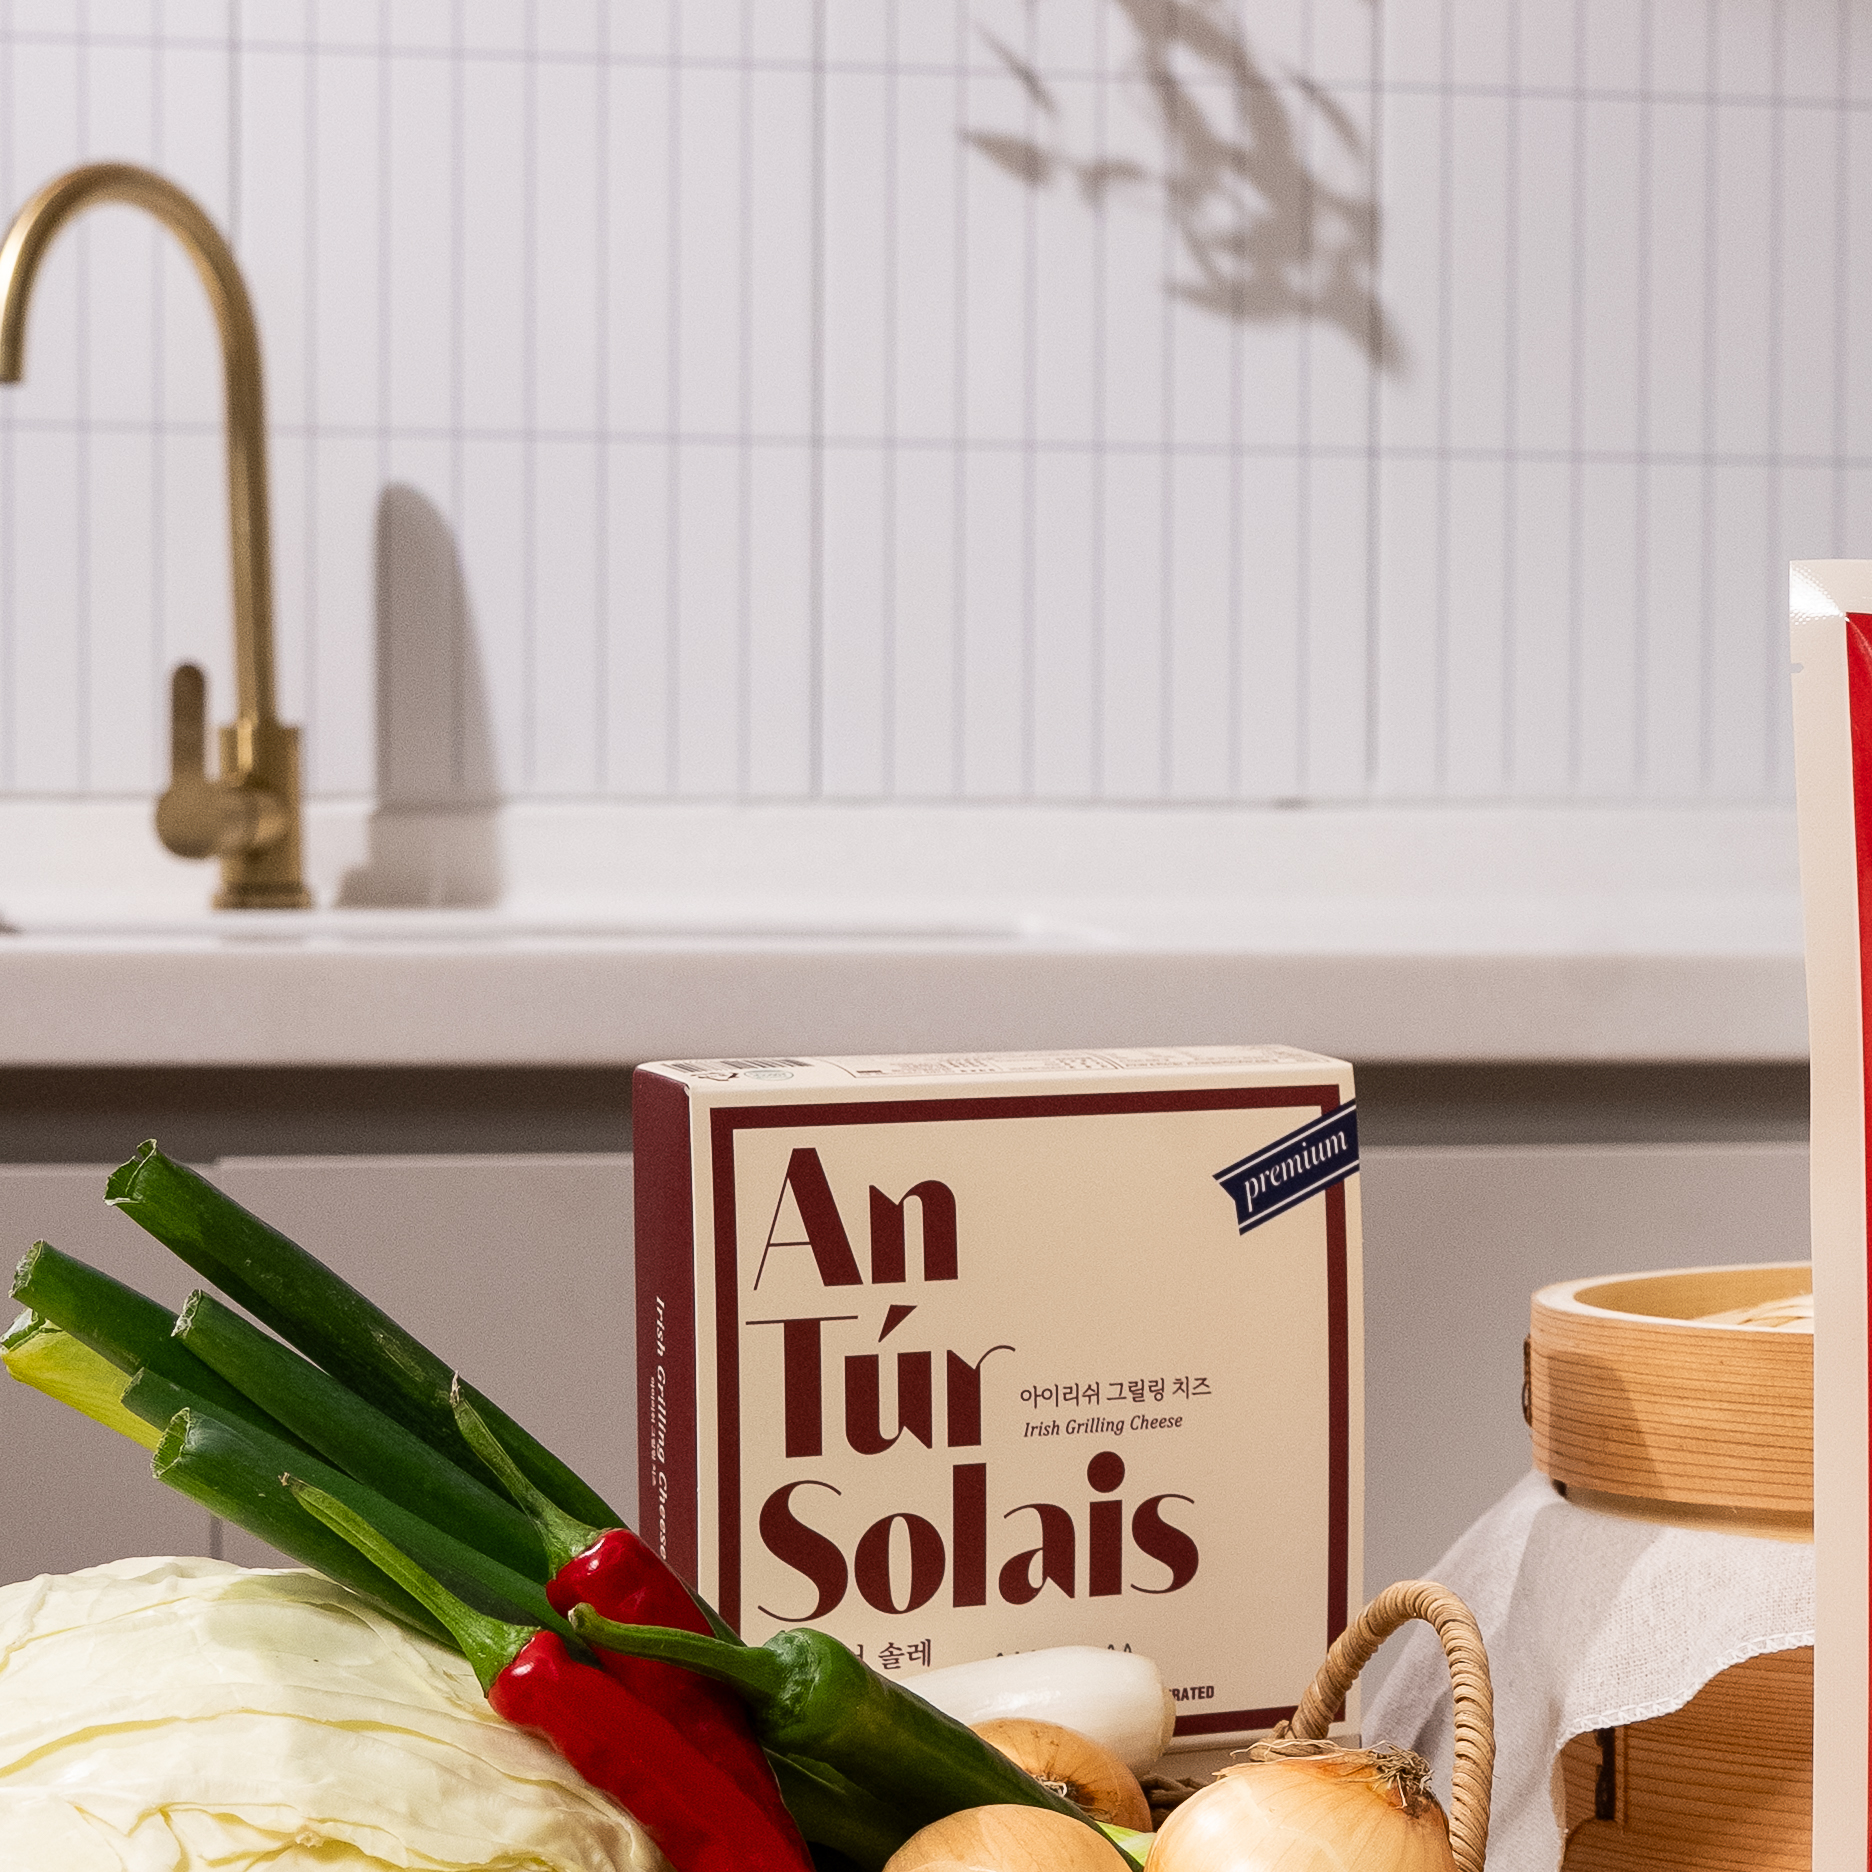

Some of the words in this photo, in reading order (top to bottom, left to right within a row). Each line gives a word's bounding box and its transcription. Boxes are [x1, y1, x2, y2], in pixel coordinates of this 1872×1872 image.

[1243, 1130, 1349, 1213] premium
[754, 1147, 959, 1290] An
[655, 1296, 666, 1357] Irish
[656, 1365, 667, 1464] Grilling
[745, 1304, 1016, 1459] Túr
[1020, 1381, 1100, 1409] 아이리쉬
[1106, 1377, 1165, 1403] 그릴링
[1172, 1376, 1212, 1400] 치즈
[1023, 1420, 1060, 1438] Irish
[1065, 1417, 1125, 1436] Grilling
[1130, 1414, 1183, 1431] Cheese
[658, 1471, 668, 1560] Cheese
[757, 1450, 1200, 1622] Solais
[878, 1638, 931, 1670] 솔레
[1168, 1685, 1215, 1702] RATED
